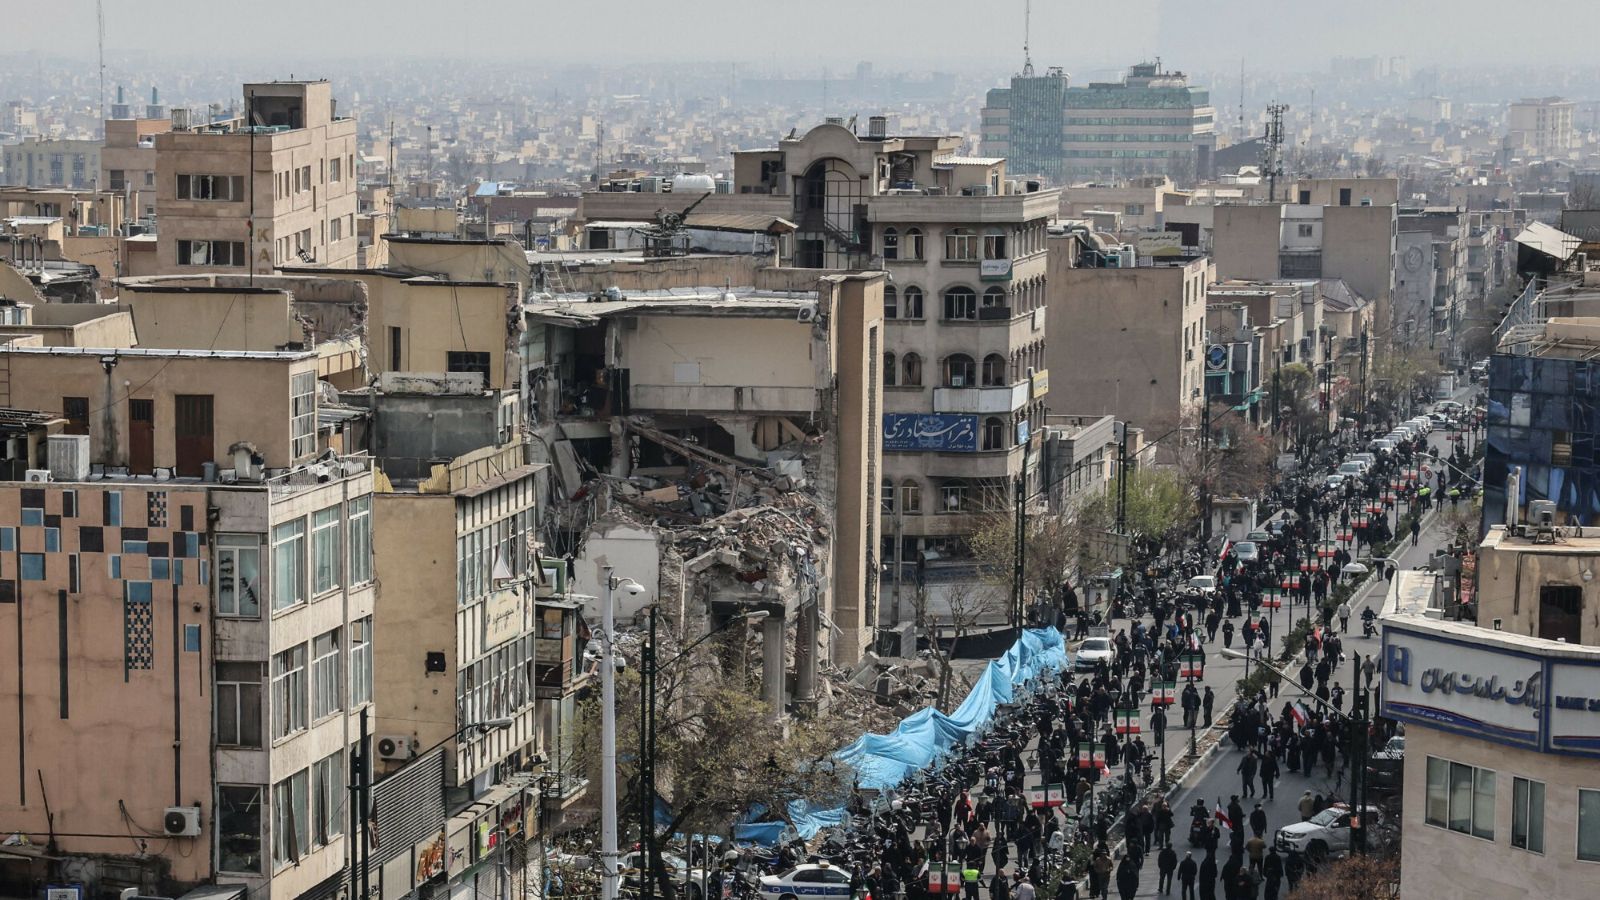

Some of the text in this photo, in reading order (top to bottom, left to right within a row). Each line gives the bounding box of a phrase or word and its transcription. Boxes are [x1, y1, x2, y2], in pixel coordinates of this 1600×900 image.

[884, 416, 974, 443] دفتر اسناد رسمی
